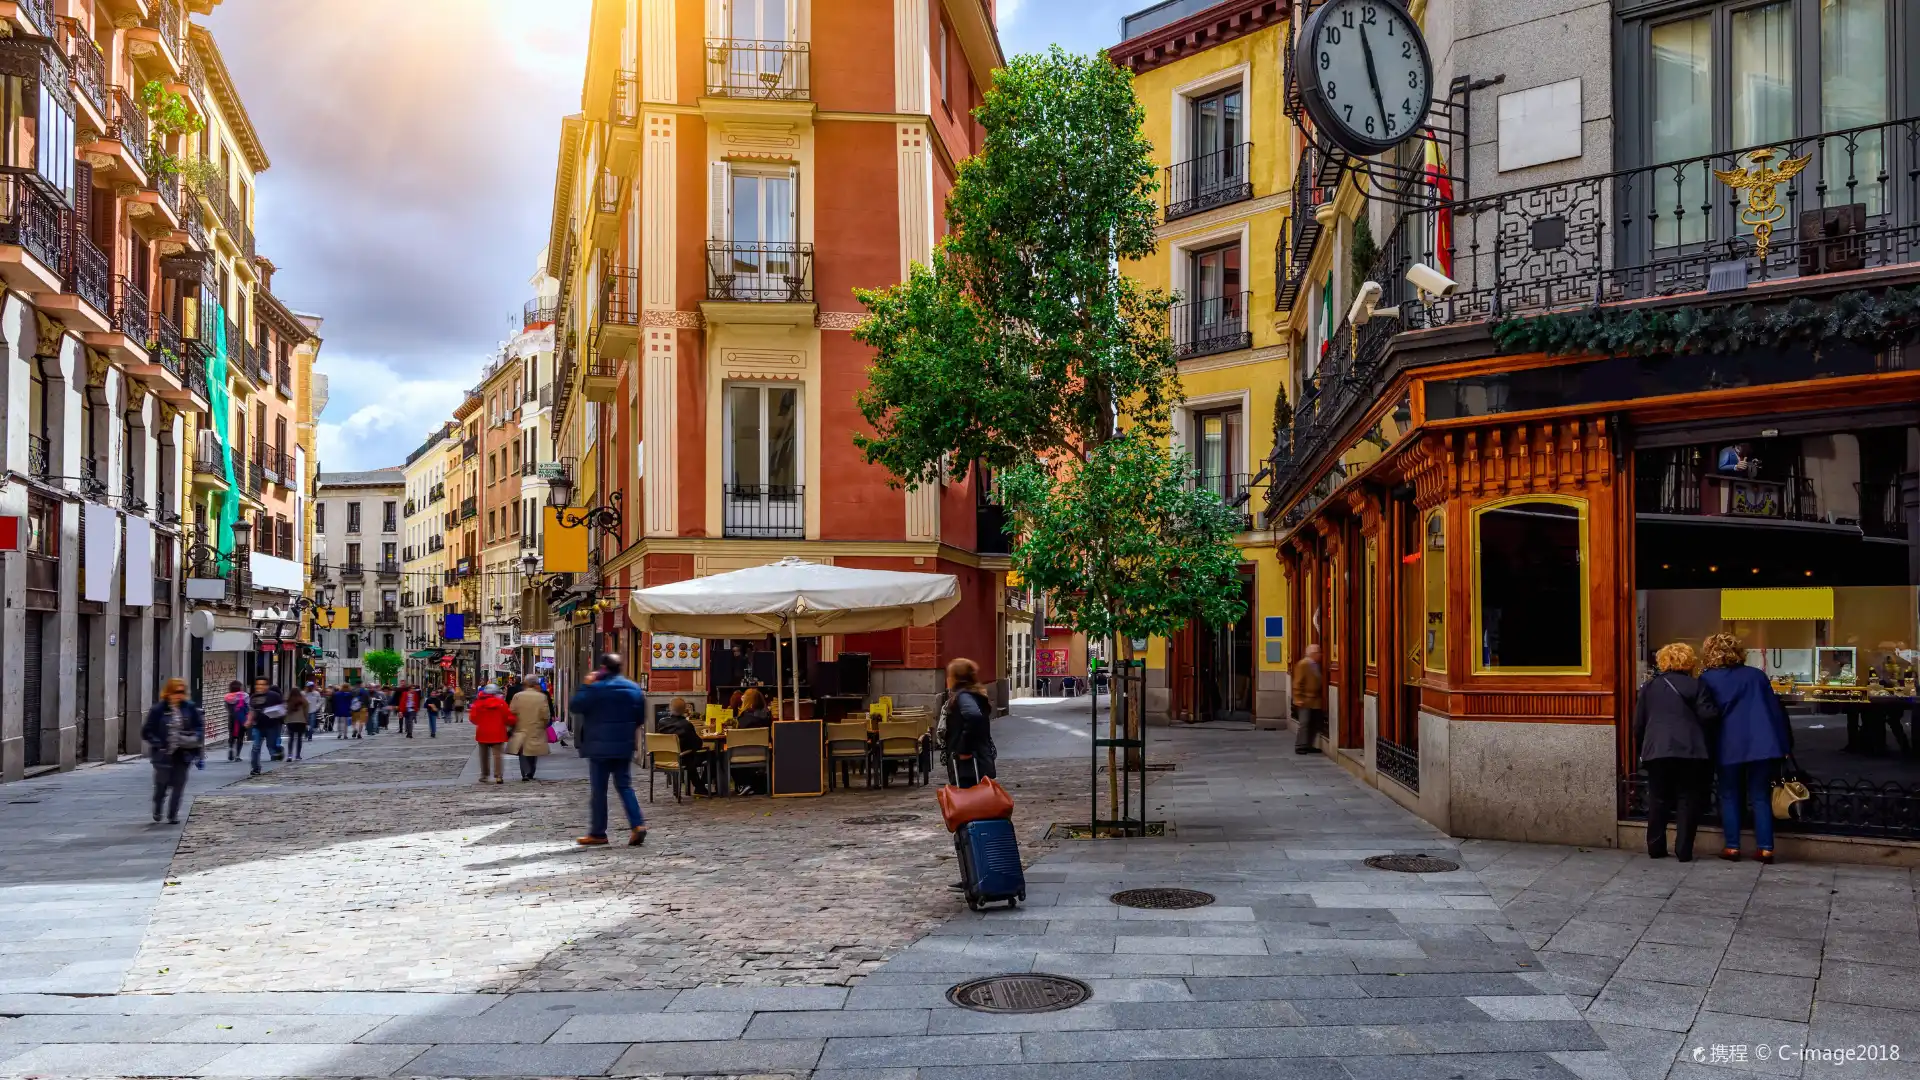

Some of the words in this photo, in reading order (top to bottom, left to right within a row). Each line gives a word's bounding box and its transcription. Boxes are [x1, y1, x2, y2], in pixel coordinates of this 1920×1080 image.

[1342, 10, 1355, 29] 11
[1361, 6, 1377, 25] 12
[1326, 26, 1341, 45] 10
[1387, 18, 1394, 36] 1
[1402, 41, 1411, 59] 2
[1320, 52, 1330, 70] 9
[1408, 71, 1417, 89] 3
[1327, 81, 1336, 100] 8
[1343, 104, 1353, 123] 7
[1402, 98, 1411, 115] 4
[1365, 115, 1374, 134] 6
[1387, 113, 1396, 131] 5
